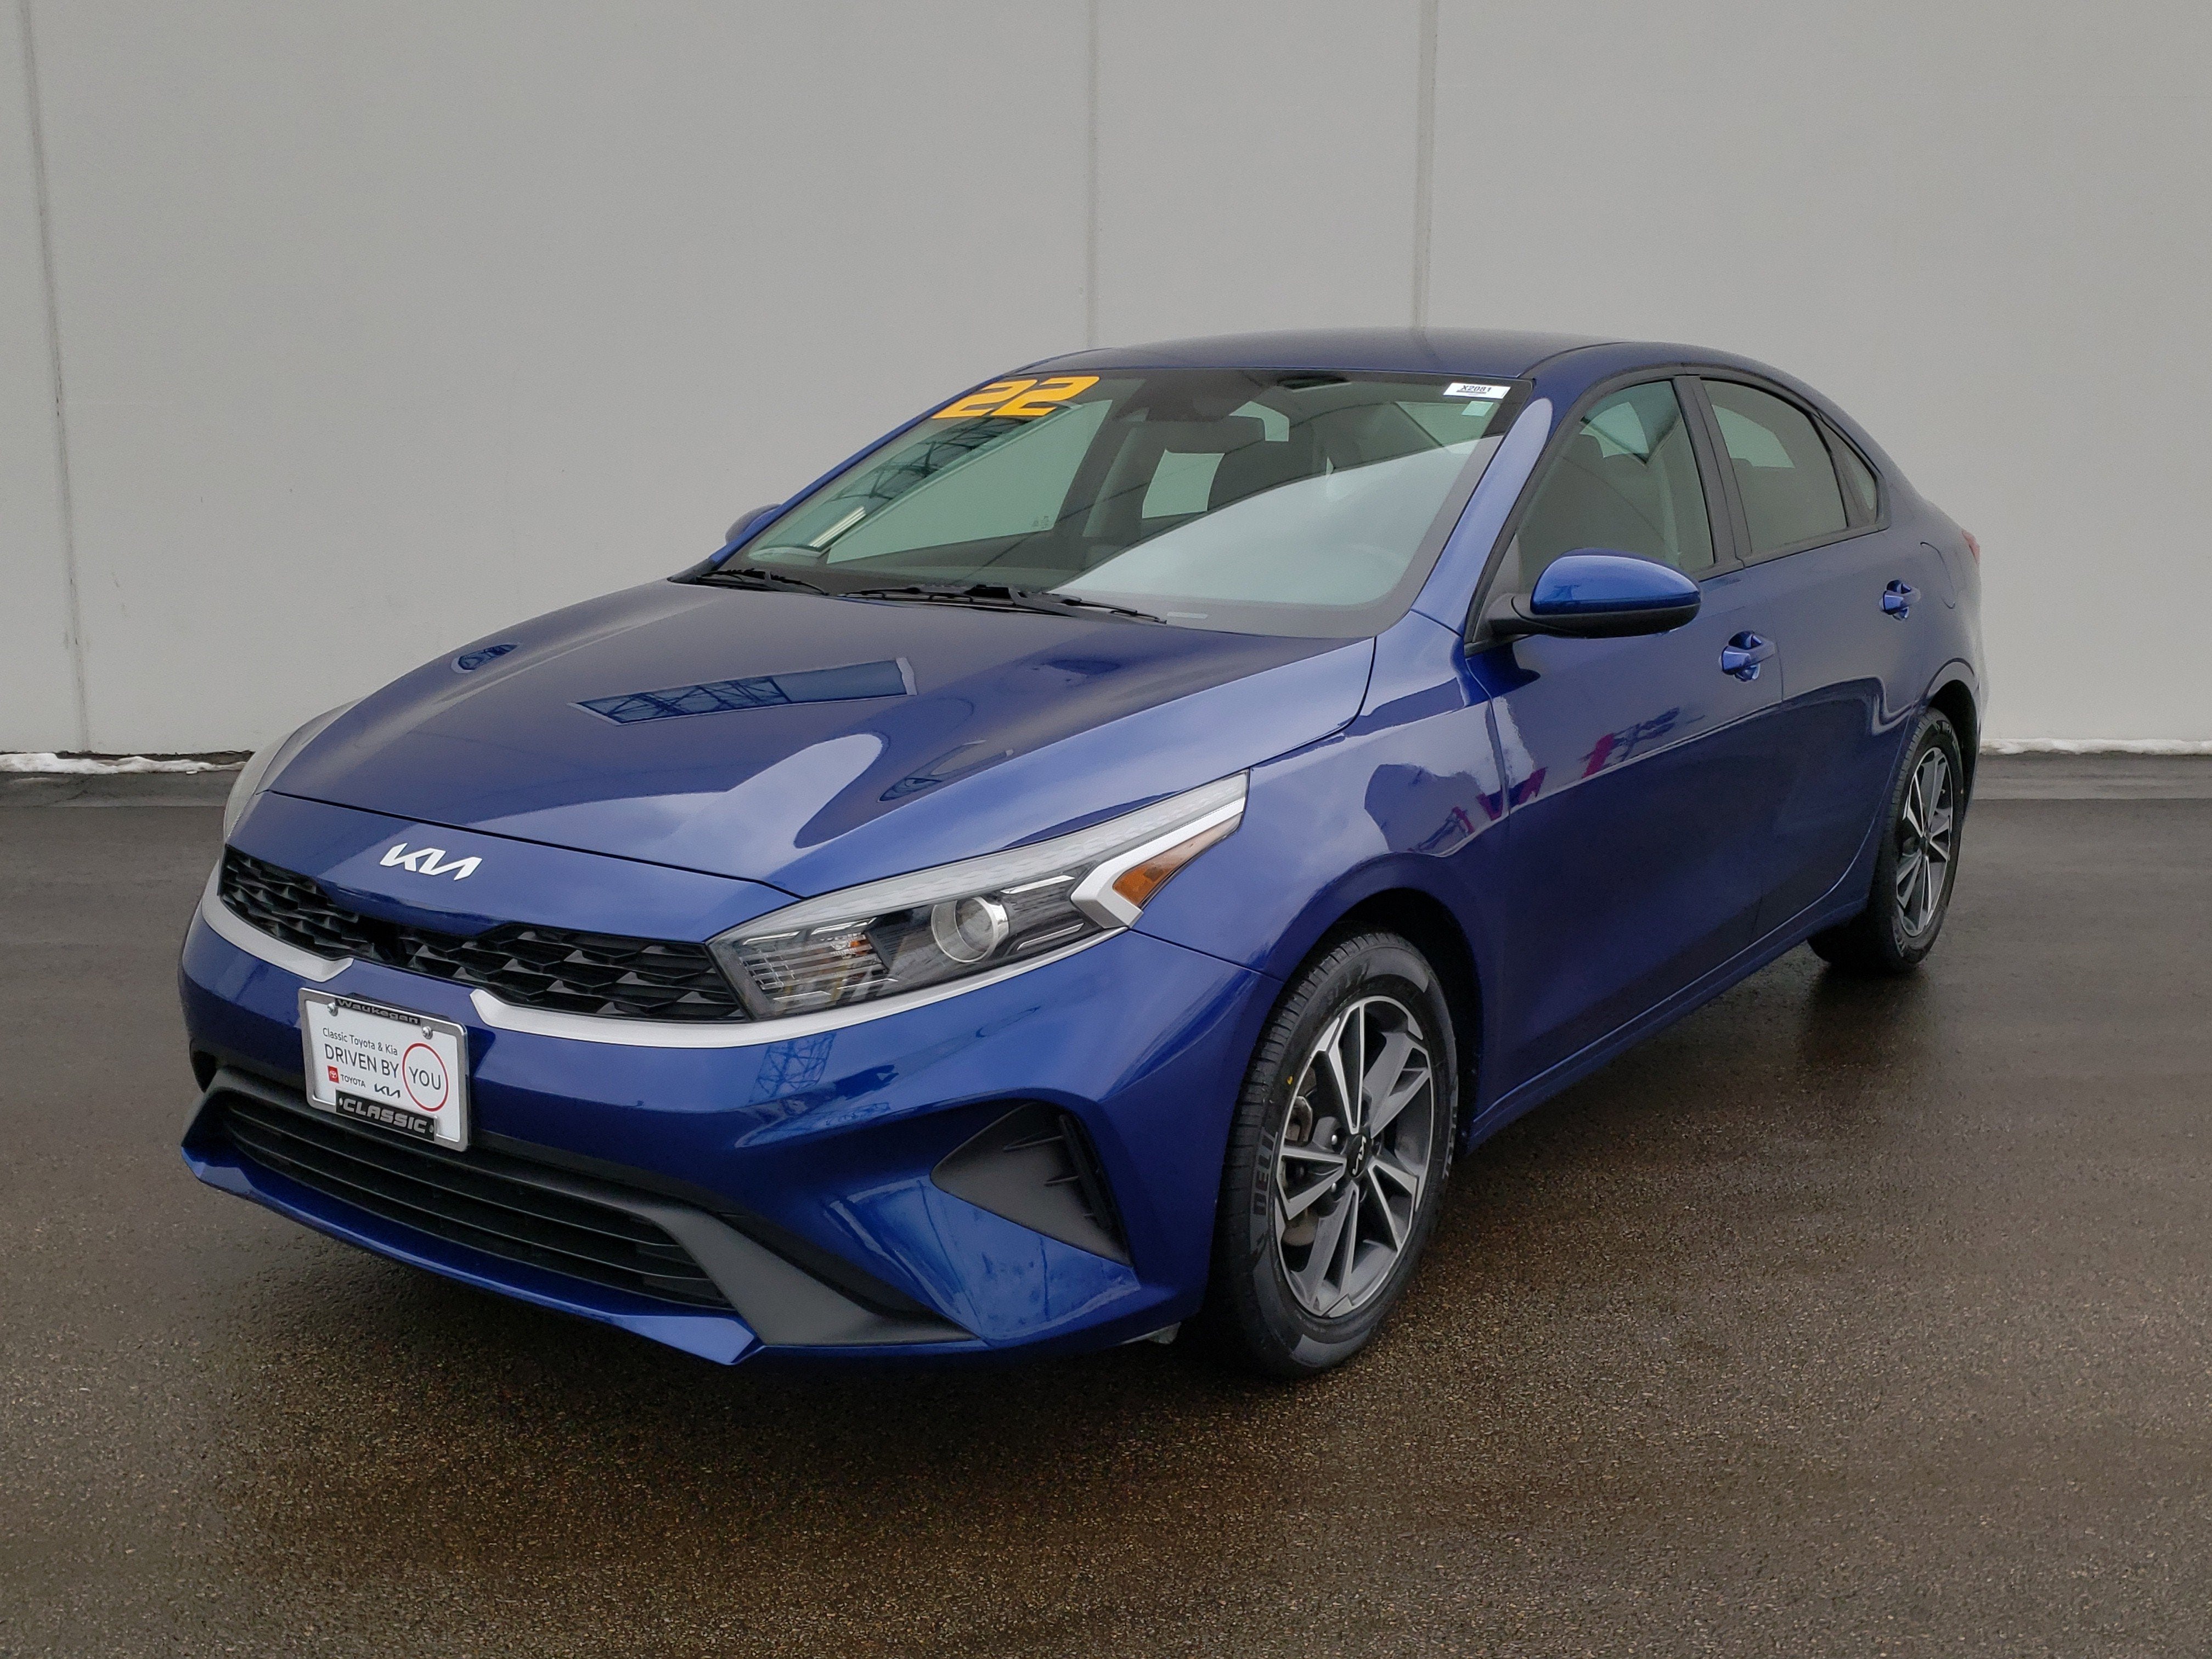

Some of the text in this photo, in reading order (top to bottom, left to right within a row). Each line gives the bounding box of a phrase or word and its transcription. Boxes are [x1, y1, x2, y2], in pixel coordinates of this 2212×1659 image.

[931, 376, 1101, 419] 22
[380, 842, 483, 881] KIA
[337, 998, 419, 1025] Waukegan
[323, 1028, 398, 1056] Classic Toyota & Kia
[324, 1043, 441, 1091] DRIVEN BY YOU
[340, 1074, 366, 1088] TOYOTA
[374, 1083, 401, 1099] KIA
[342, 1097, 428, 1134] CLASSIC
